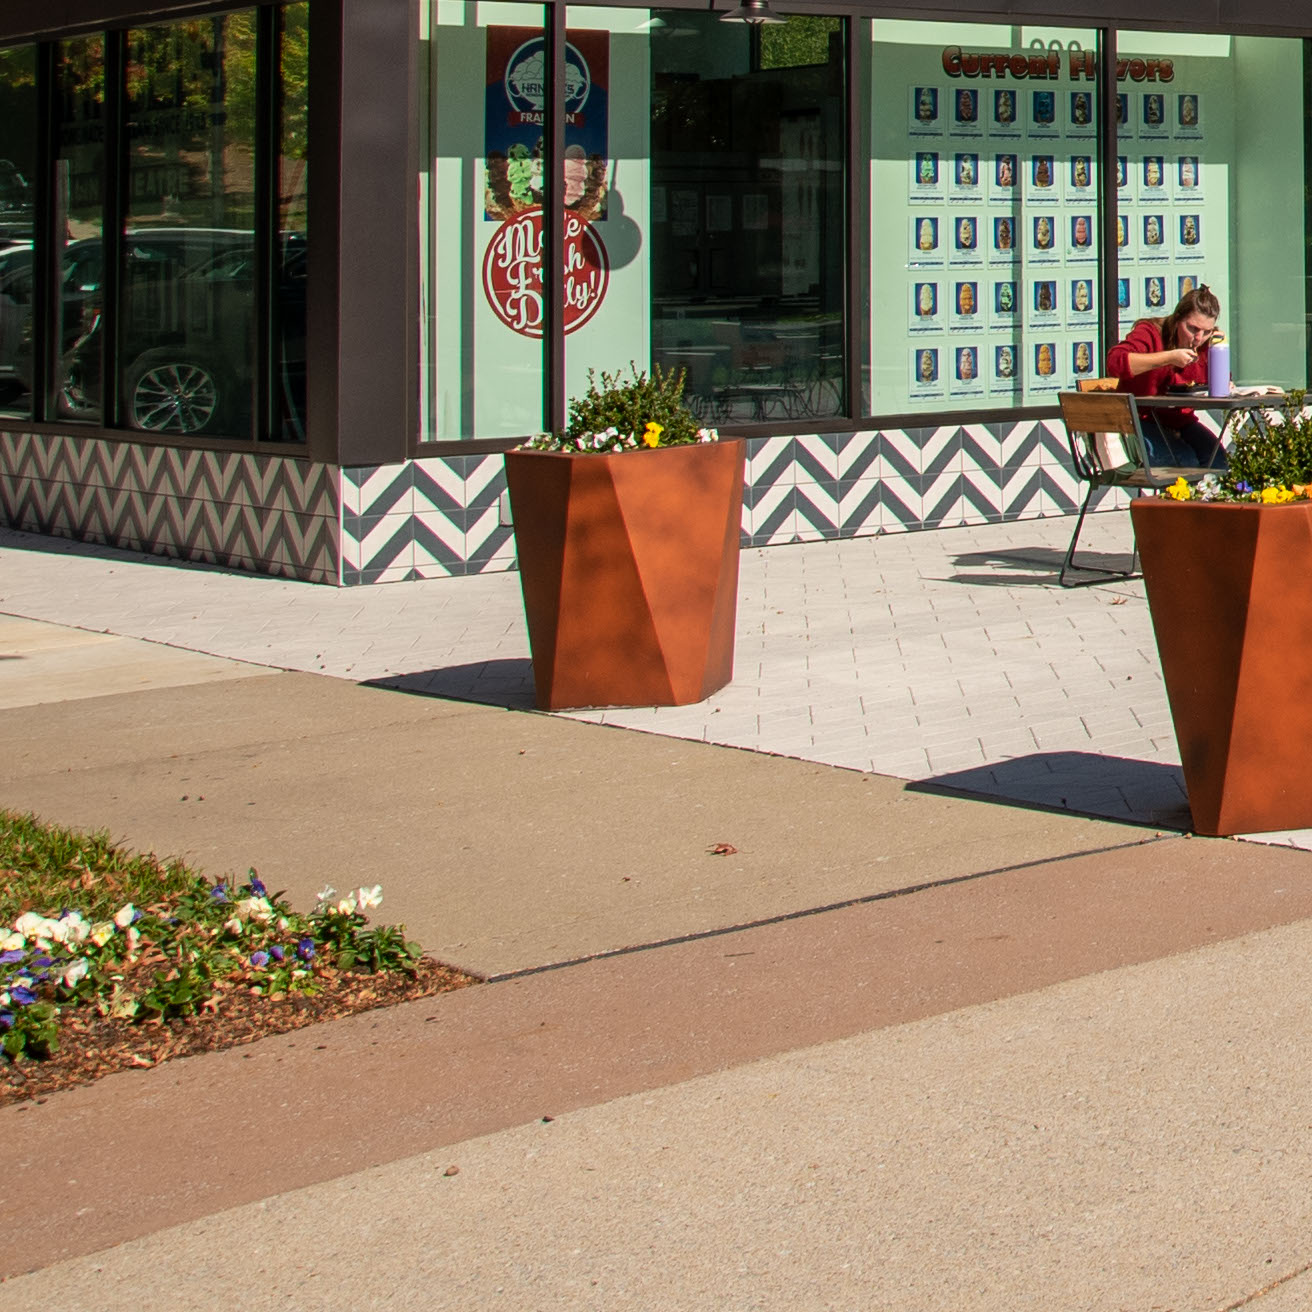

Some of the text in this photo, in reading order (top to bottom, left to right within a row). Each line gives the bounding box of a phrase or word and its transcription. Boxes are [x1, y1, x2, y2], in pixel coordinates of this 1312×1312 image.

[942, 44, 1175, 83] Current Flvors
[520, 112, 575, 123] FRAN
[498, 213, 582, 267] Me
[507, 243, 585, 298] Frh
[506, 271, 596, 329] Dly!
